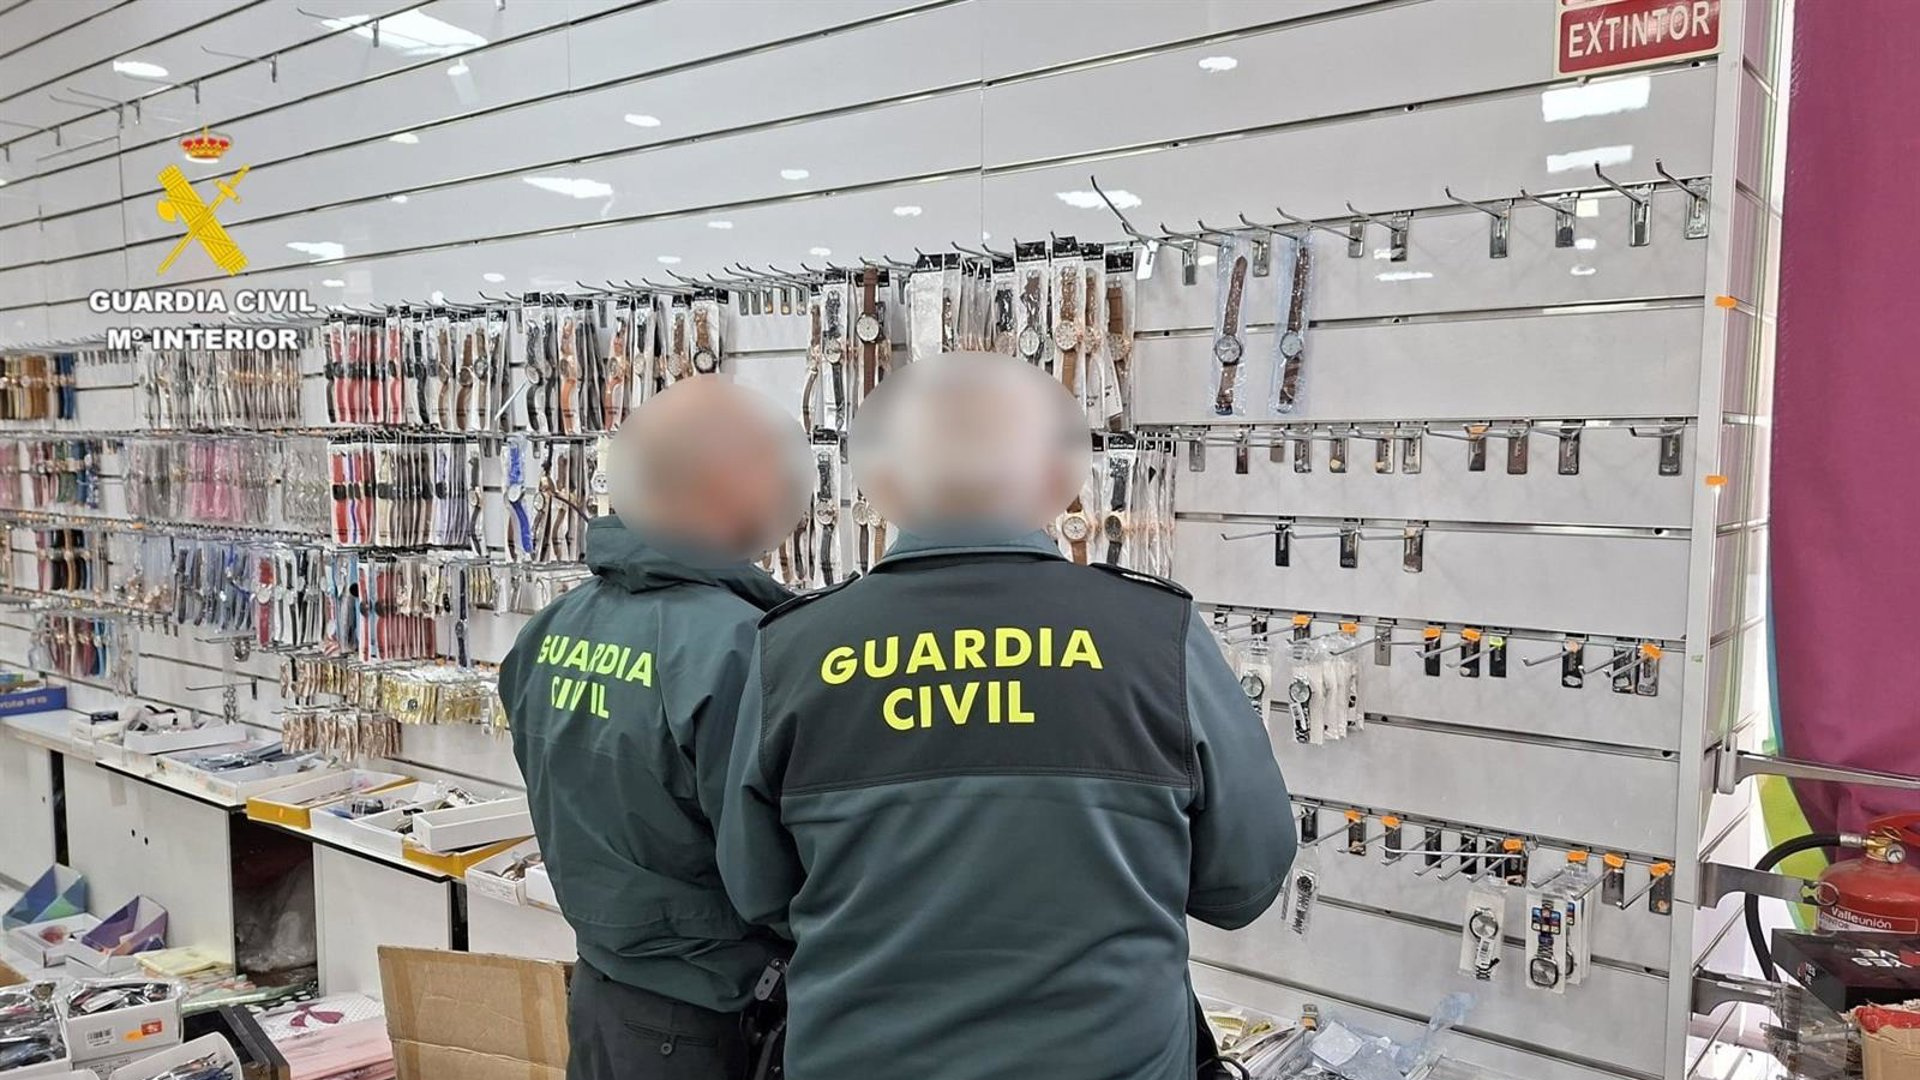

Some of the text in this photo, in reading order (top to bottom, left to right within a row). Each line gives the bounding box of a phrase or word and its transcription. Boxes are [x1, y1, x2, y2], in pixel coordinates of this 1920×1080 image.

[1568, 1, 1711, 58] EXTINTOR
[536, 634, 653, 688] GUARDIA
[820, 626, 1104, 685] GUARDIA
[882, 680, 1036, 731] CIVIL
